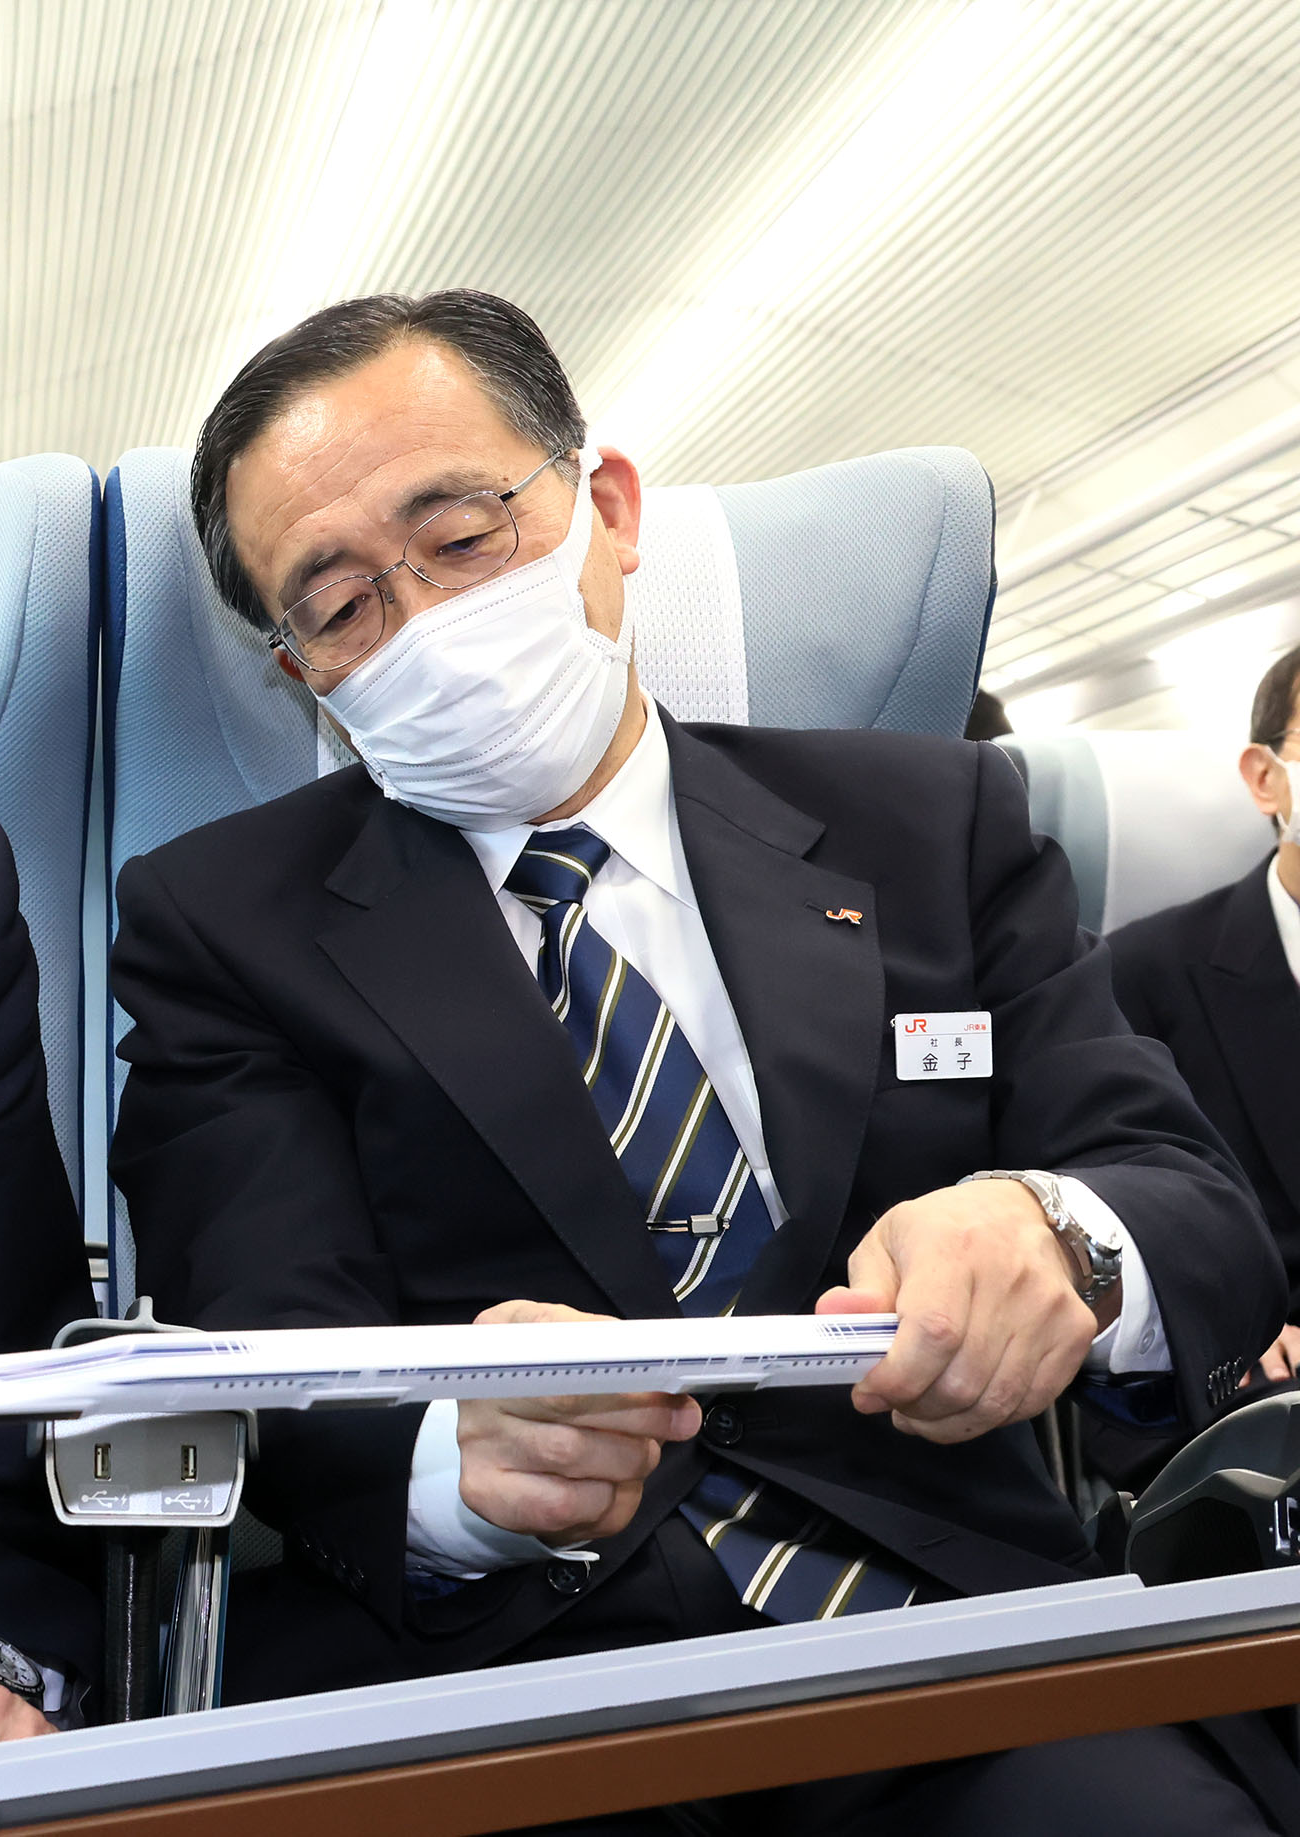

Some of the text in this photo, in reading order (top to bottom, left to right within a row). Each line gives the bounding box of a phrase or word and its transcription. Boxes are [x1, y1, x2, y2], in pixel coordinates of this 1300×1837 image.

[825, 908, 862, 924] JR
[905, 1018, 927, 1033] JR
[922, 1052, 972, 1072] 金子
